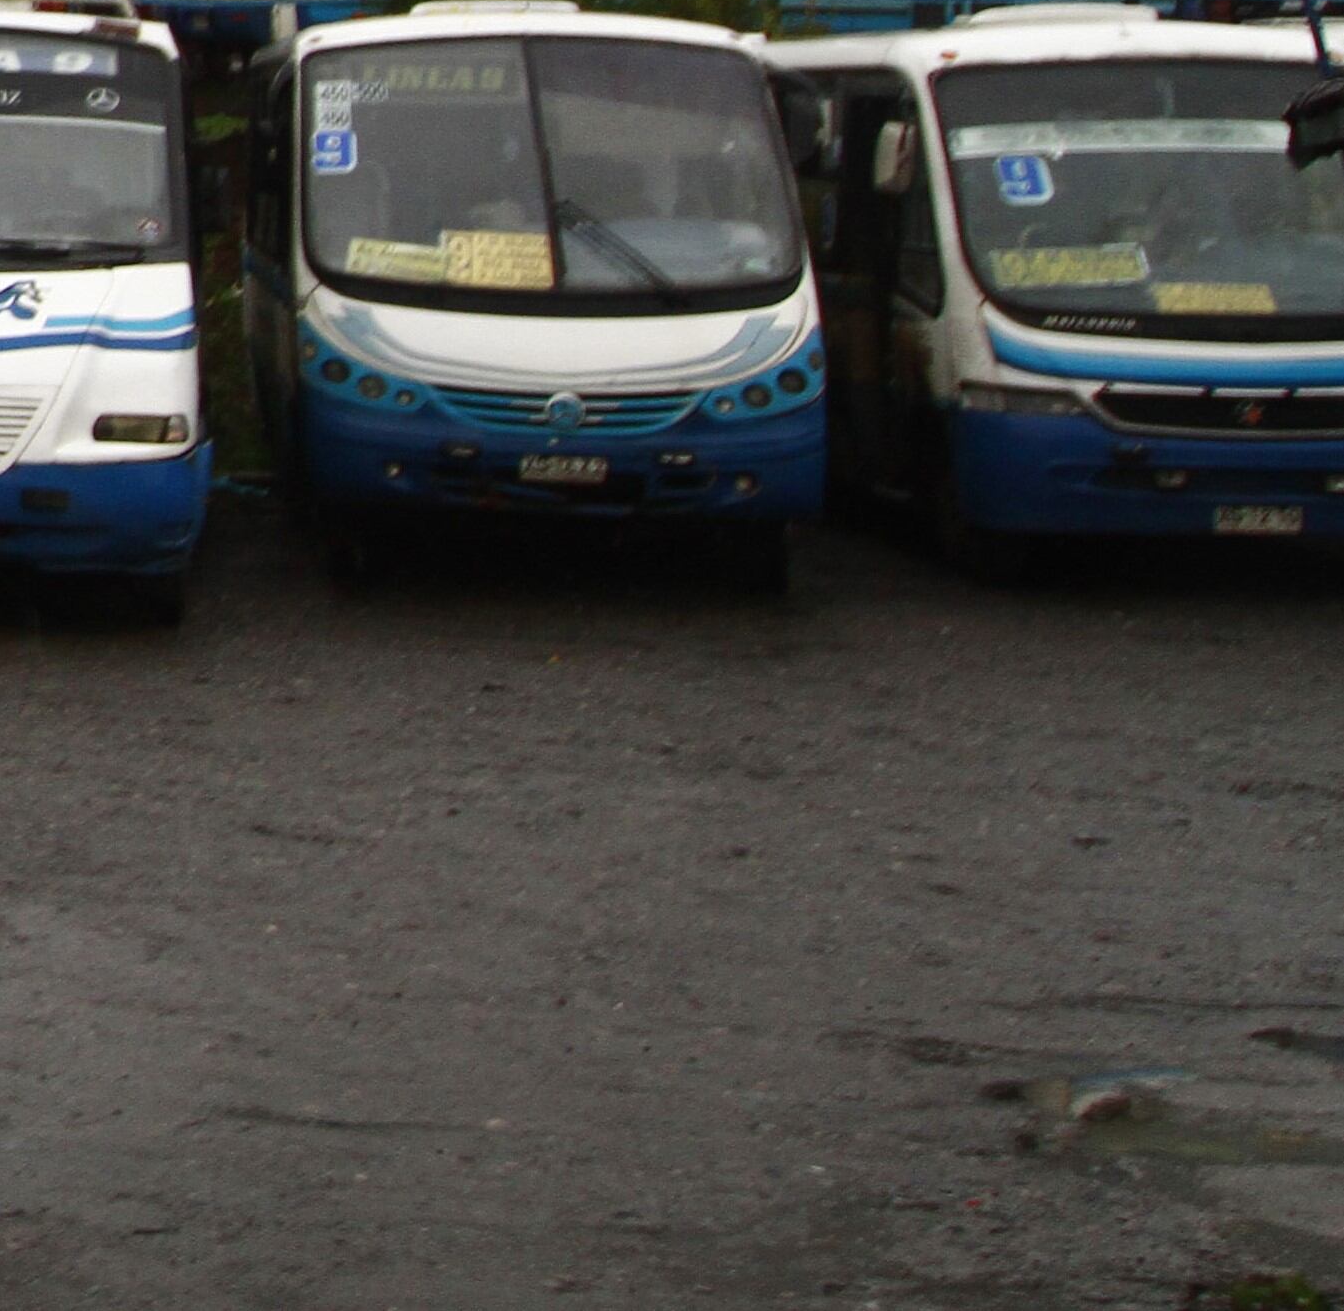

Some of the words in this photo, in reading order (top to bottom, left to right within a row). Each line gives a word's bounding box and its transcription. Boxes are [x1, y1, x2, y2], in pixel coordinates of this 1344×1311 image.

[53, 50, 95, 74] 9
[315, 130, 354, 169] 9
[998, 154, 1047, 197] 9
